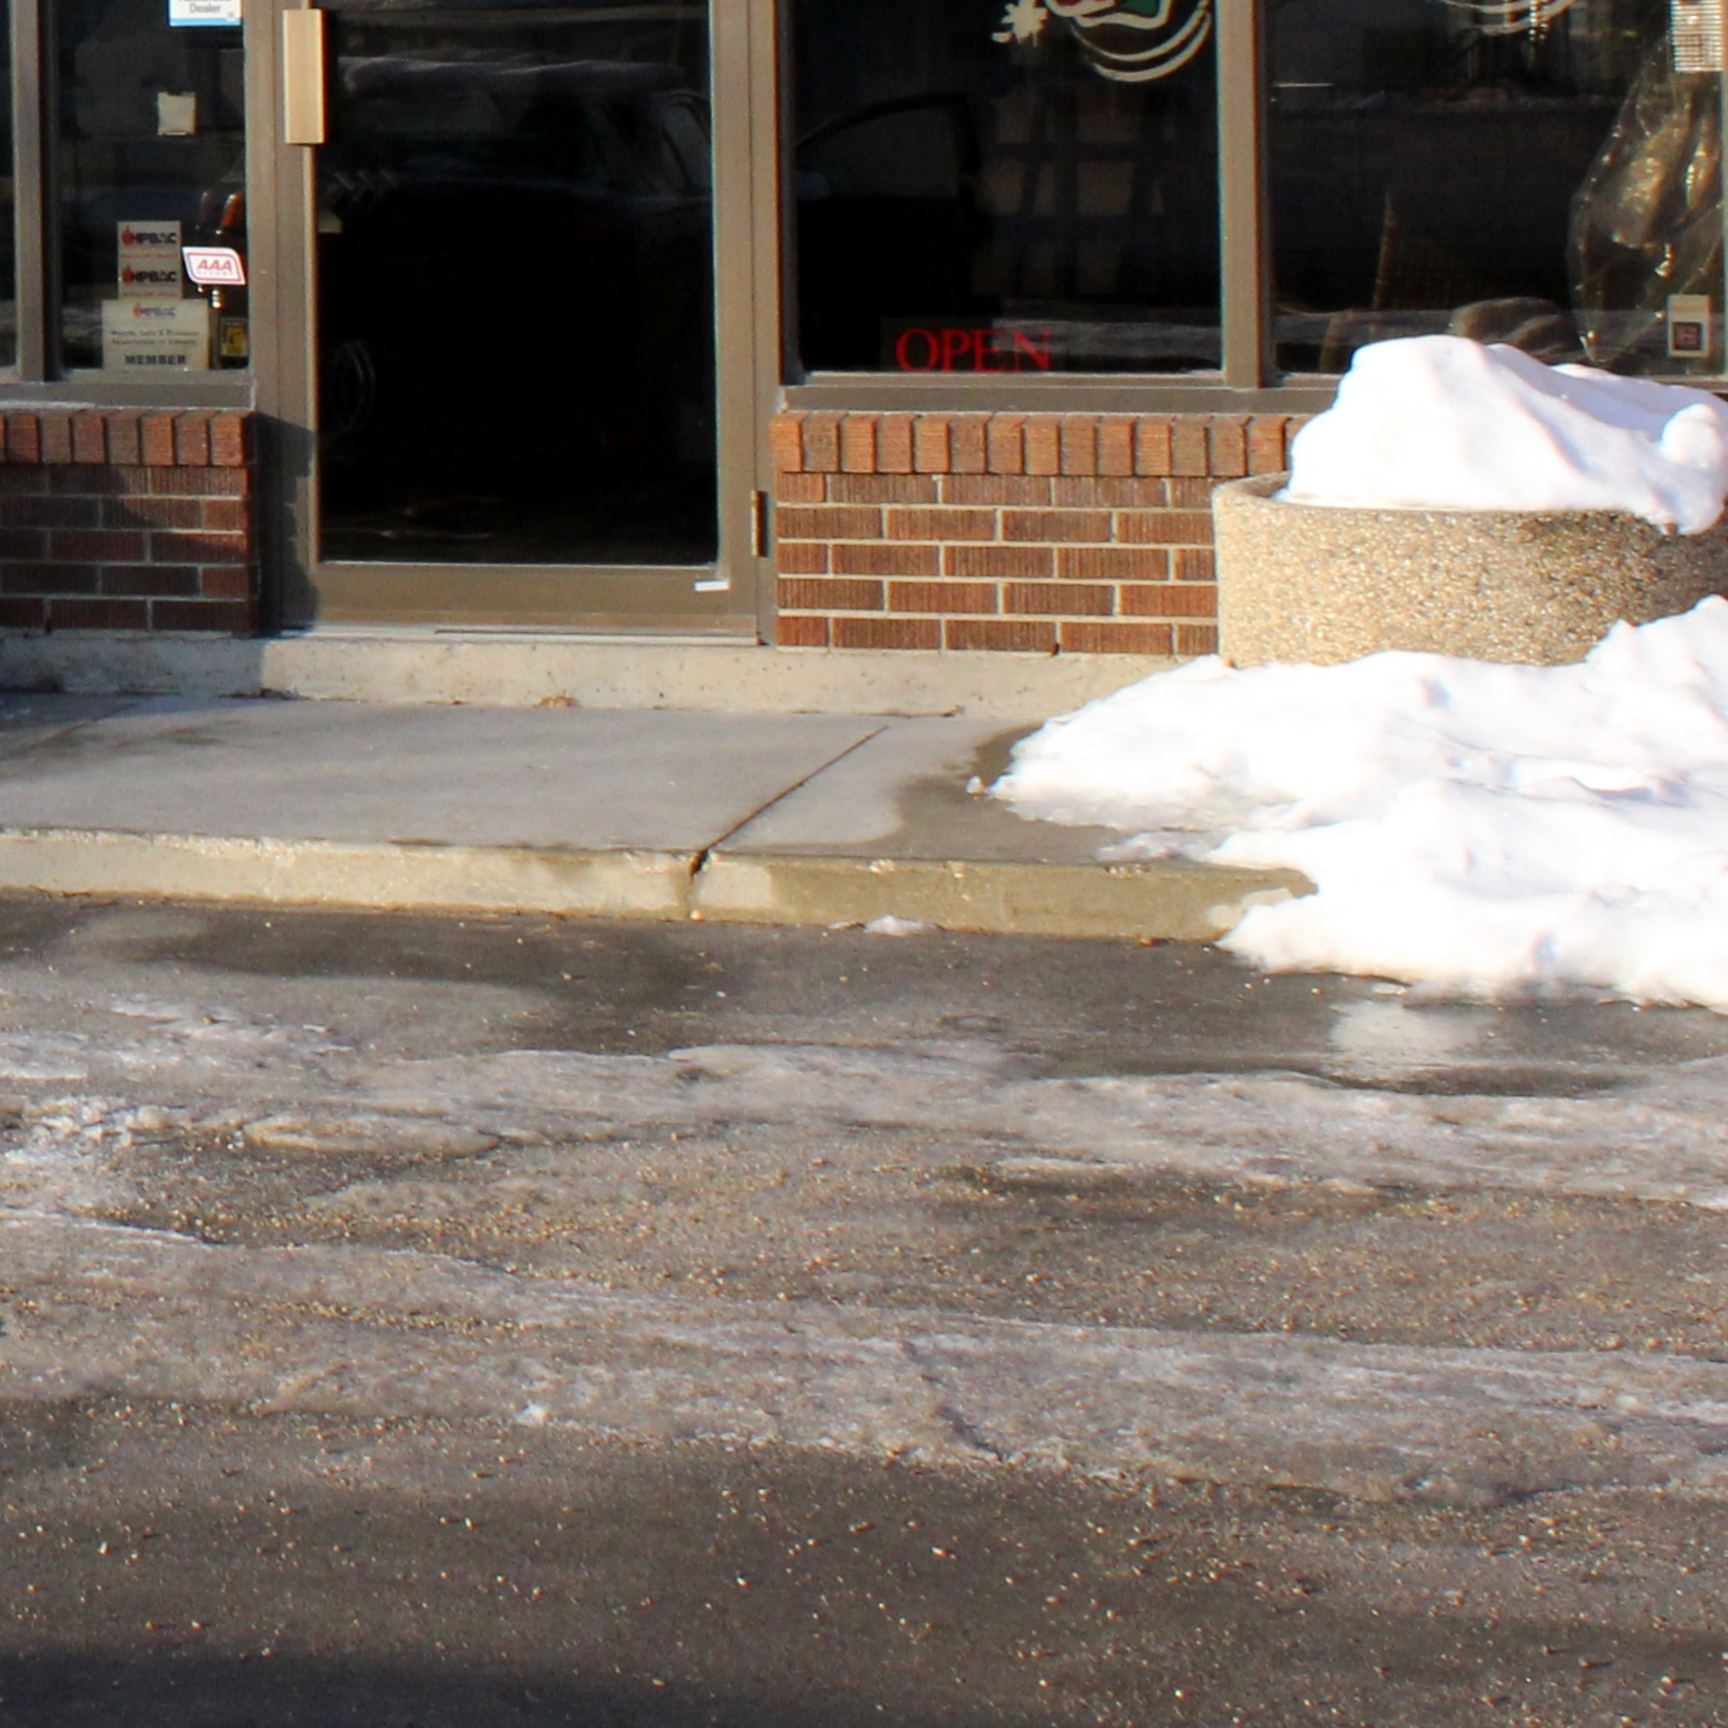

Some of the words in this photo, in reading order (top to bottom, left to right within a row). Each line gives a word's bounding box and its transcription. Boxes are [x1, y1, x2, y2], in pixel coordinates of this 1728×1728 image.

[197, 258, 233, 271] AAA
[896, 327, 1052, 373] OPEN
[124, 354, 187, 366] MEMBER
